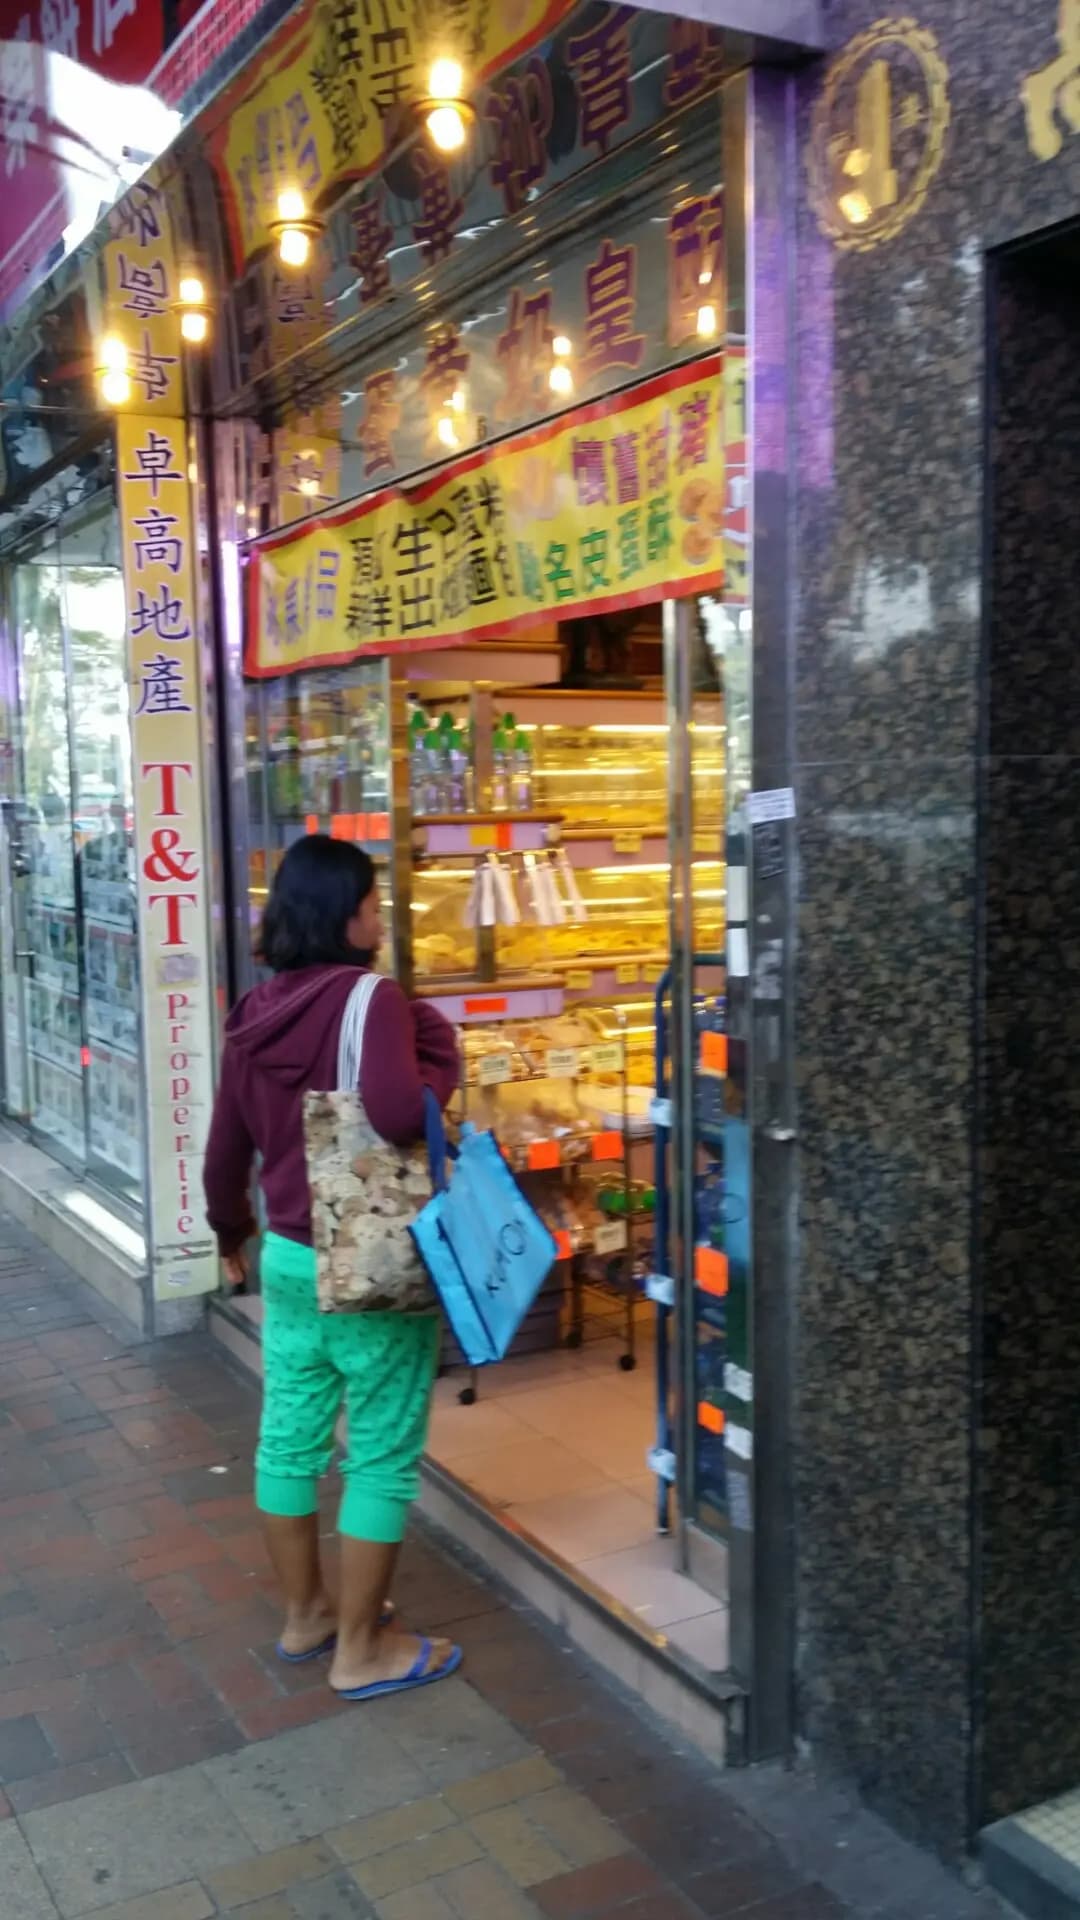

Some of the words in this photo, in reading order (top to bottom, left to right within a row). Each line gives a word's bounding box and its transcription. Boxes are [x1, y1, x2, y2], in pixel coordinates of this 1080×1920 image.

[125, 432, 192, 714] 卓高地產
[143, 764, 199, 945] T&T
